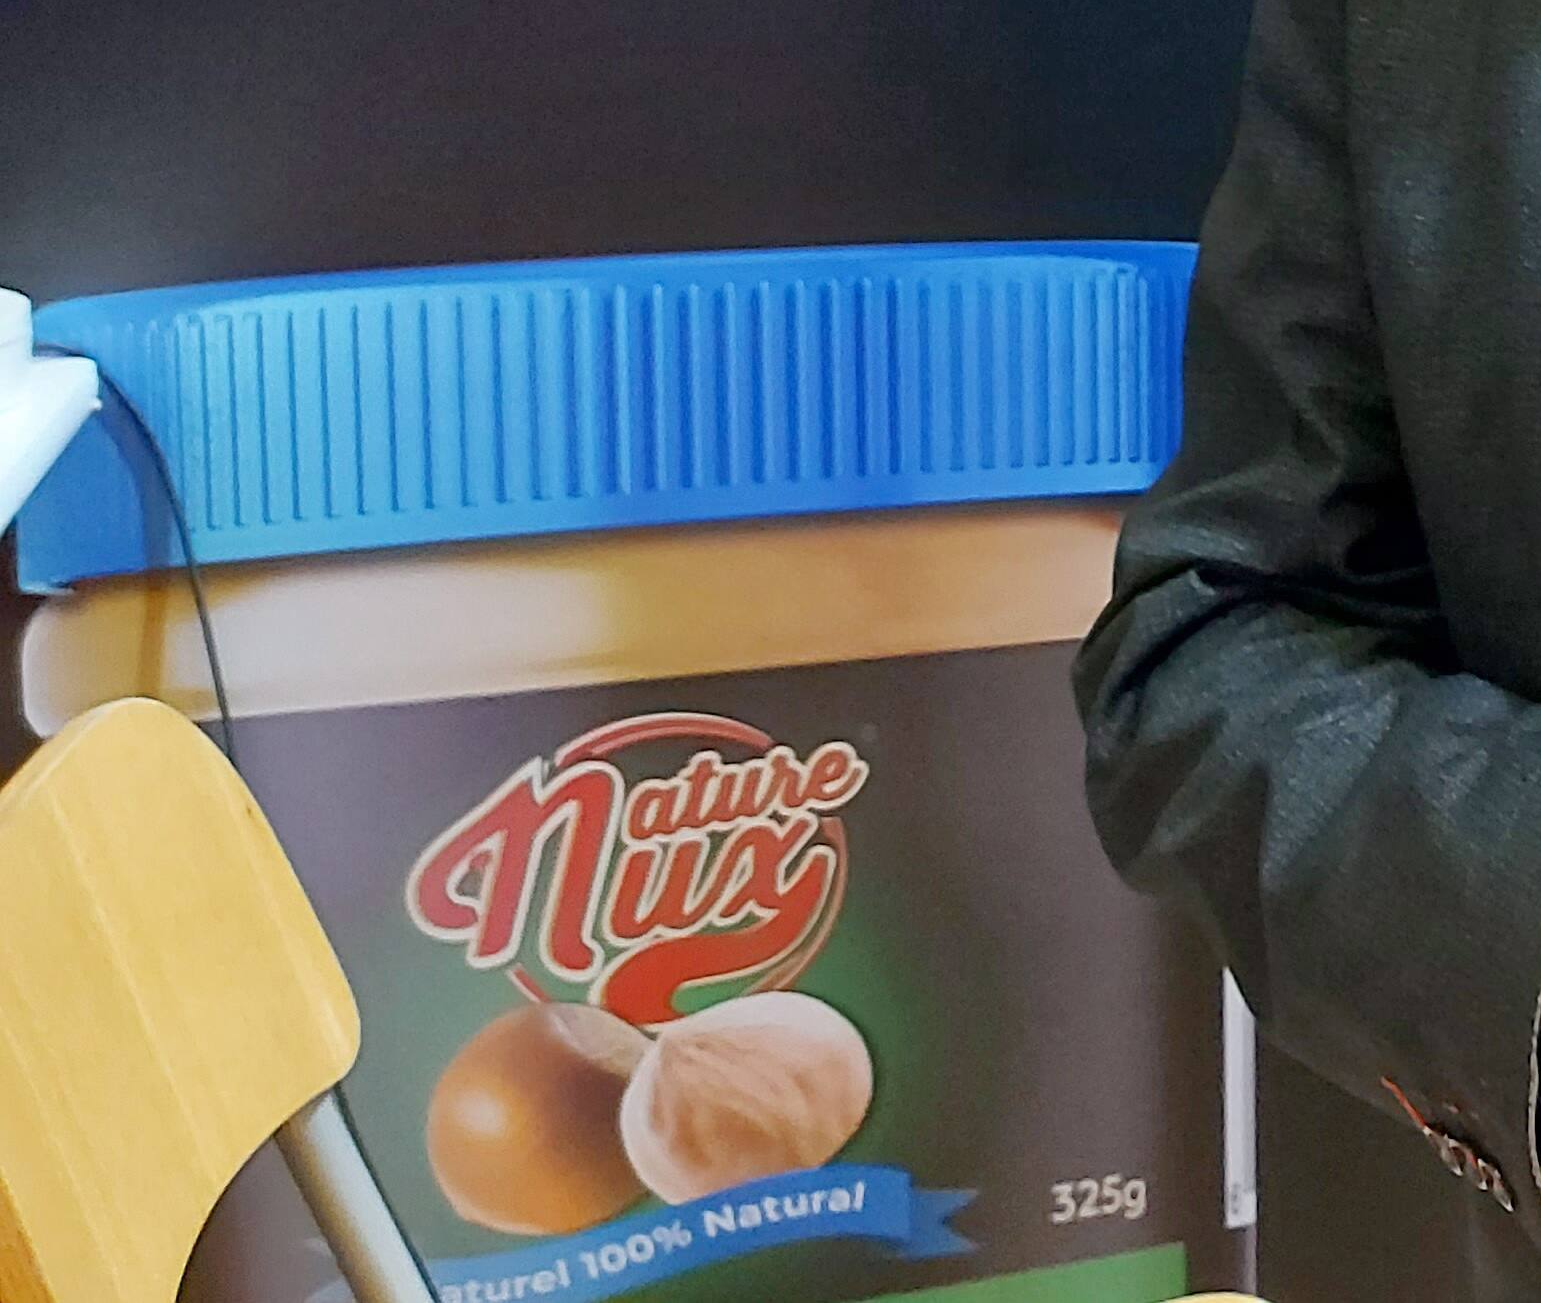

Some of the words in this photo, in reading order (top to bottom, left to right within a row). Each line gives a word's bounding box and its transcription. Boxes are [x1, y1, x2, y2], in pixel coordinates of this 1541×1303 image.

[440, 1258, 572, 1303] aturel
[580, 1219, 693, 1283] 100%
[702, 1180, 867, 1240] Natural
[1050, 1176, 1148, 1227] 325g
